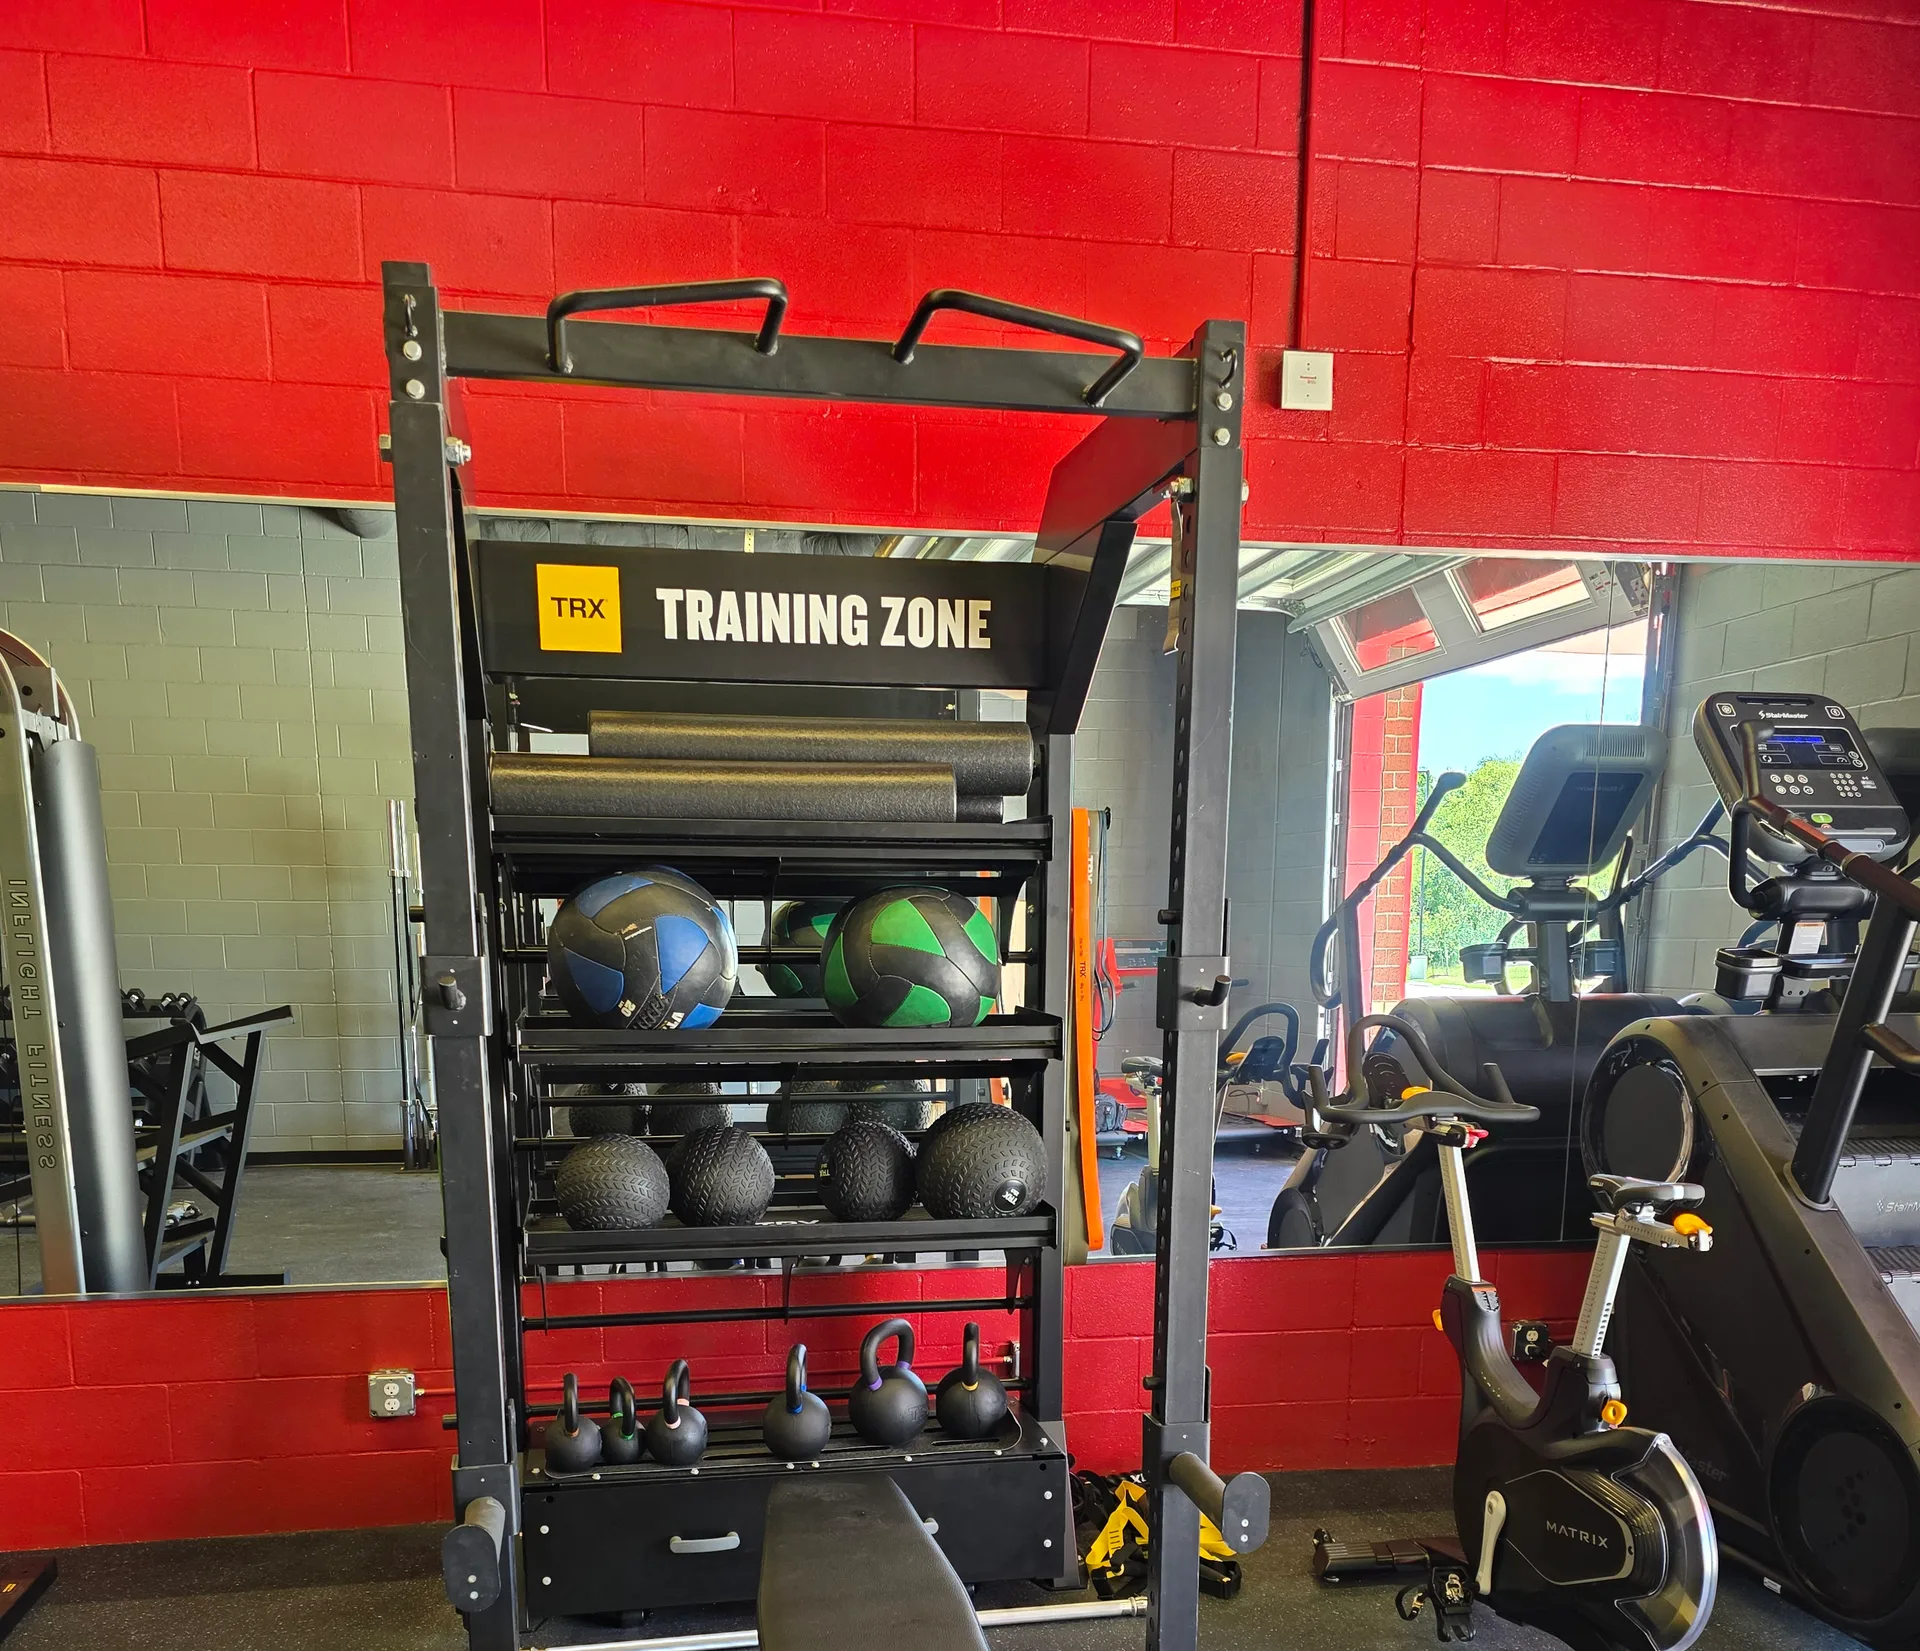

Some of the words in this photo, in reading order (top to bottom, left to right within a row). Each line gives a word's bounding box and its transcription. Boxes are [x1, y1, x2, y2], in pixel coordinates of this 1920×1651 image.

[550, 596, 606, 619] TRX
[656, 587, 868, 646] TRAINING
[880, 596, 991, 649] ZONE
[620, 999, 636, 1018] 20
[1546, 1520, 1609, 1549] MATRIX
